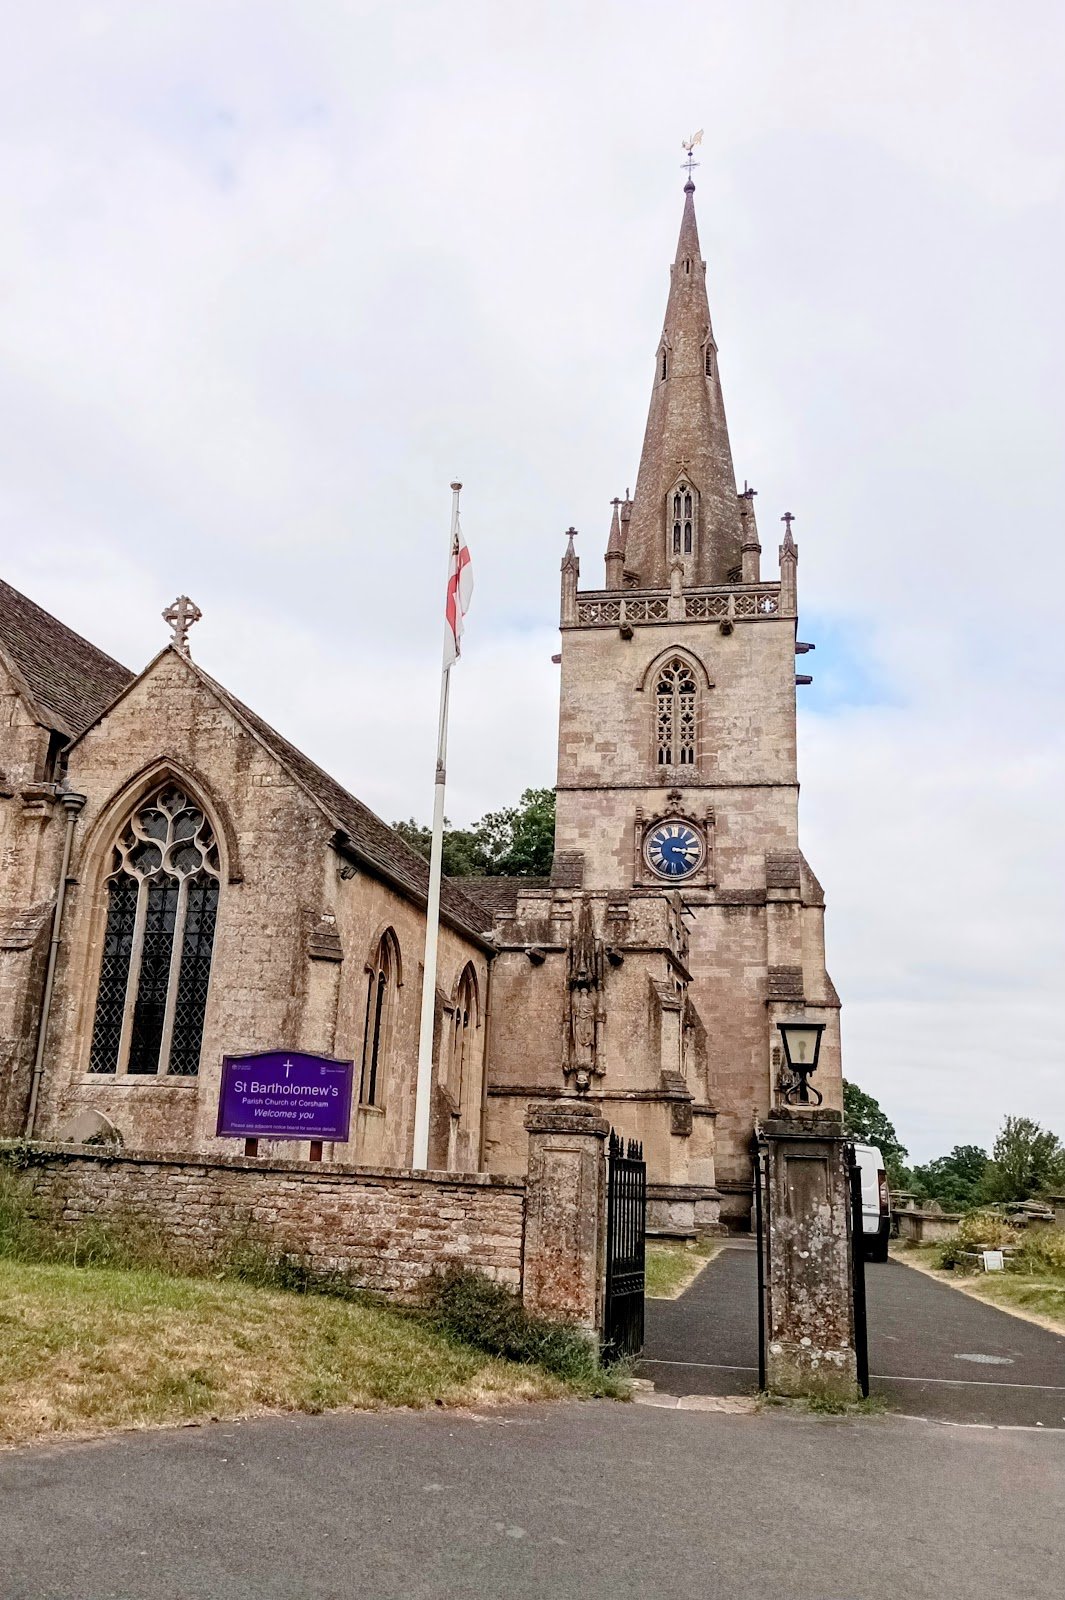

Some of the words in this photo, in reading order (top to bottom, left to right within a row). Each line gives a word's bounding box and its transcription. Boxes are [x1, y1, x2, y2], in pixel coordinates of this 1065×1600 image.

[234, 1080, 247, 1093] St
[250, 1081, 338, 1096] Bartholomew's
[242, 1097, 263, 1105] Parish
[264, 1098, 289, 1106] Church
[254, 1108, 297, 1118] Welcomes
[298, 1111, 314, 1120] you
